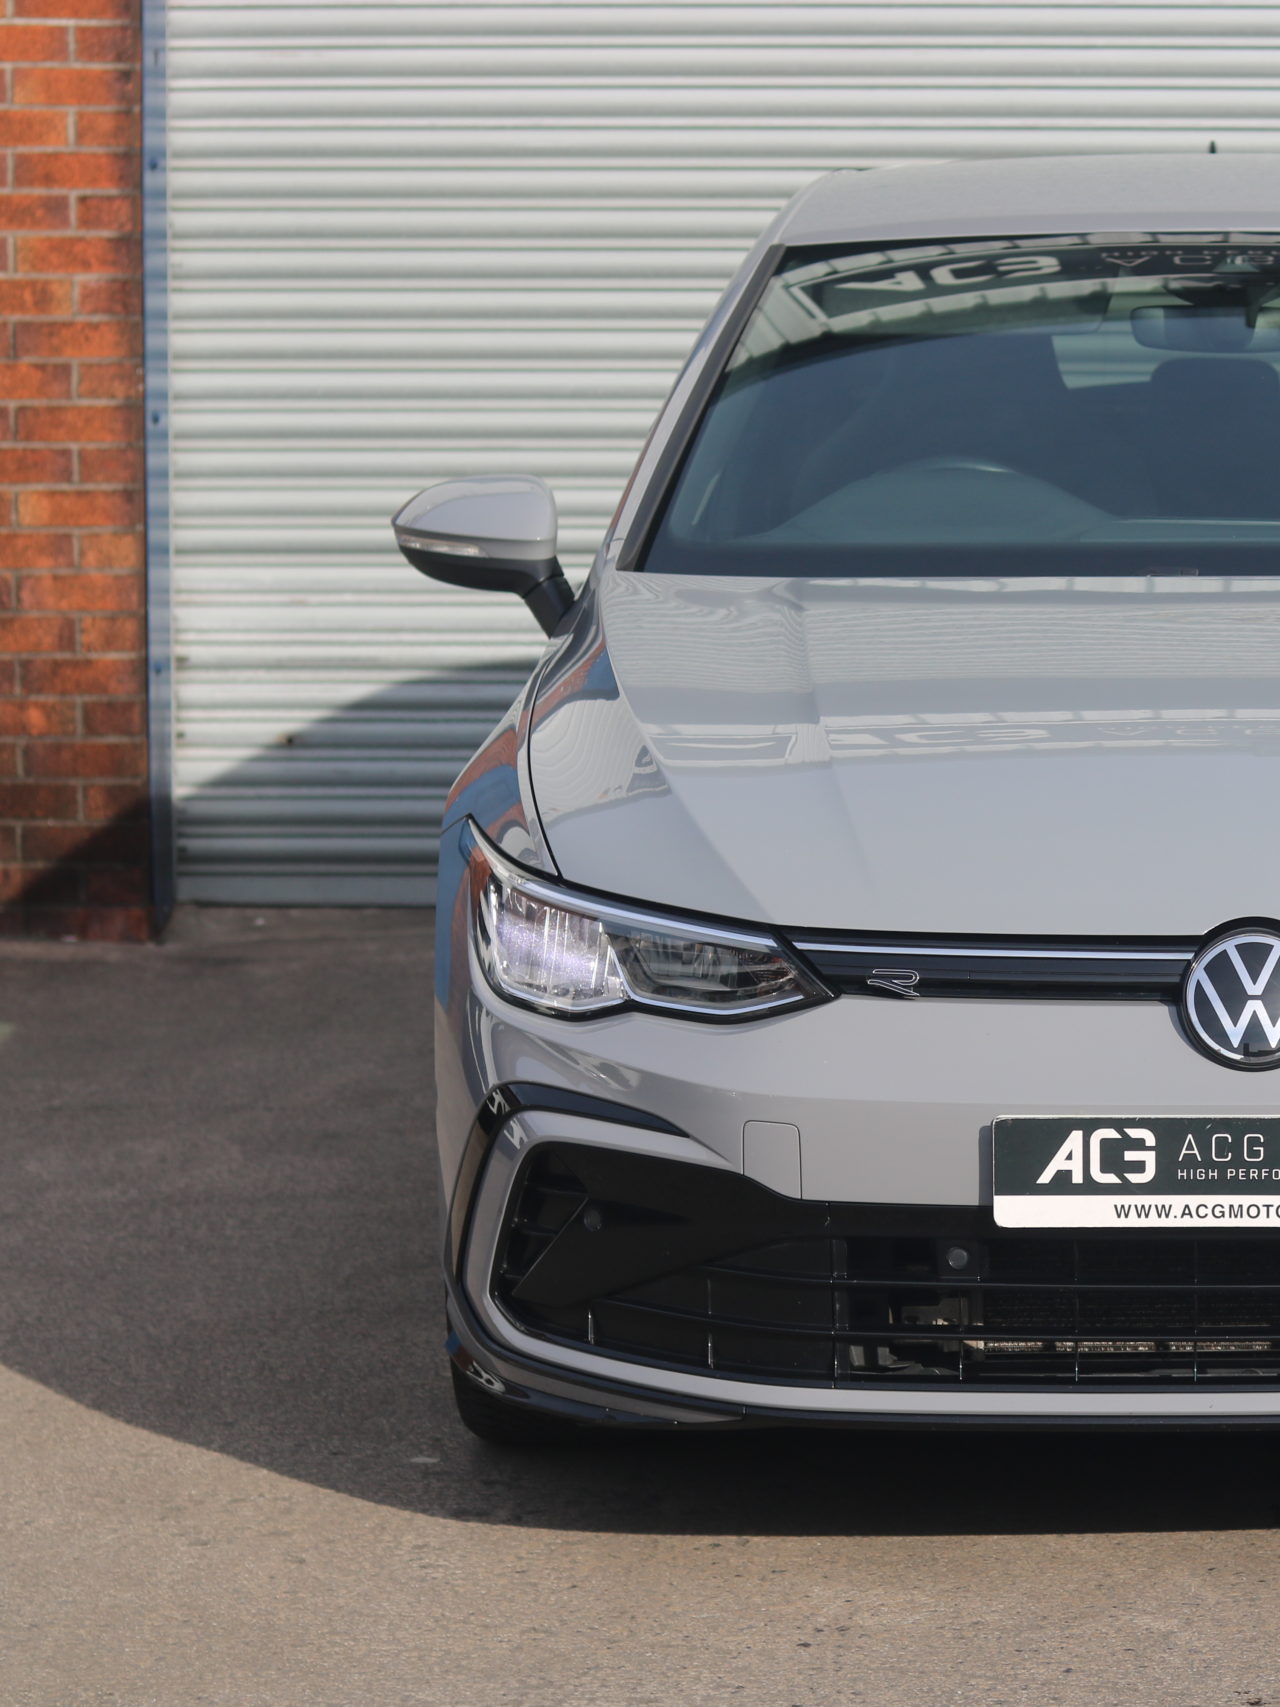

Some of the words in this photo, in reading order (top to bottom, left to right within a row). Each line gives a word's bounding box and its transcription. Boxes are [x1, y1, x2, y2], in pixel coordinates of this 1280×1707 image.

[1035, 1127, 1157, 1184] ACG
[1178, 1133, 1266, 1162] ACG
[1177, 1168, 1218, 1181] HIGH
